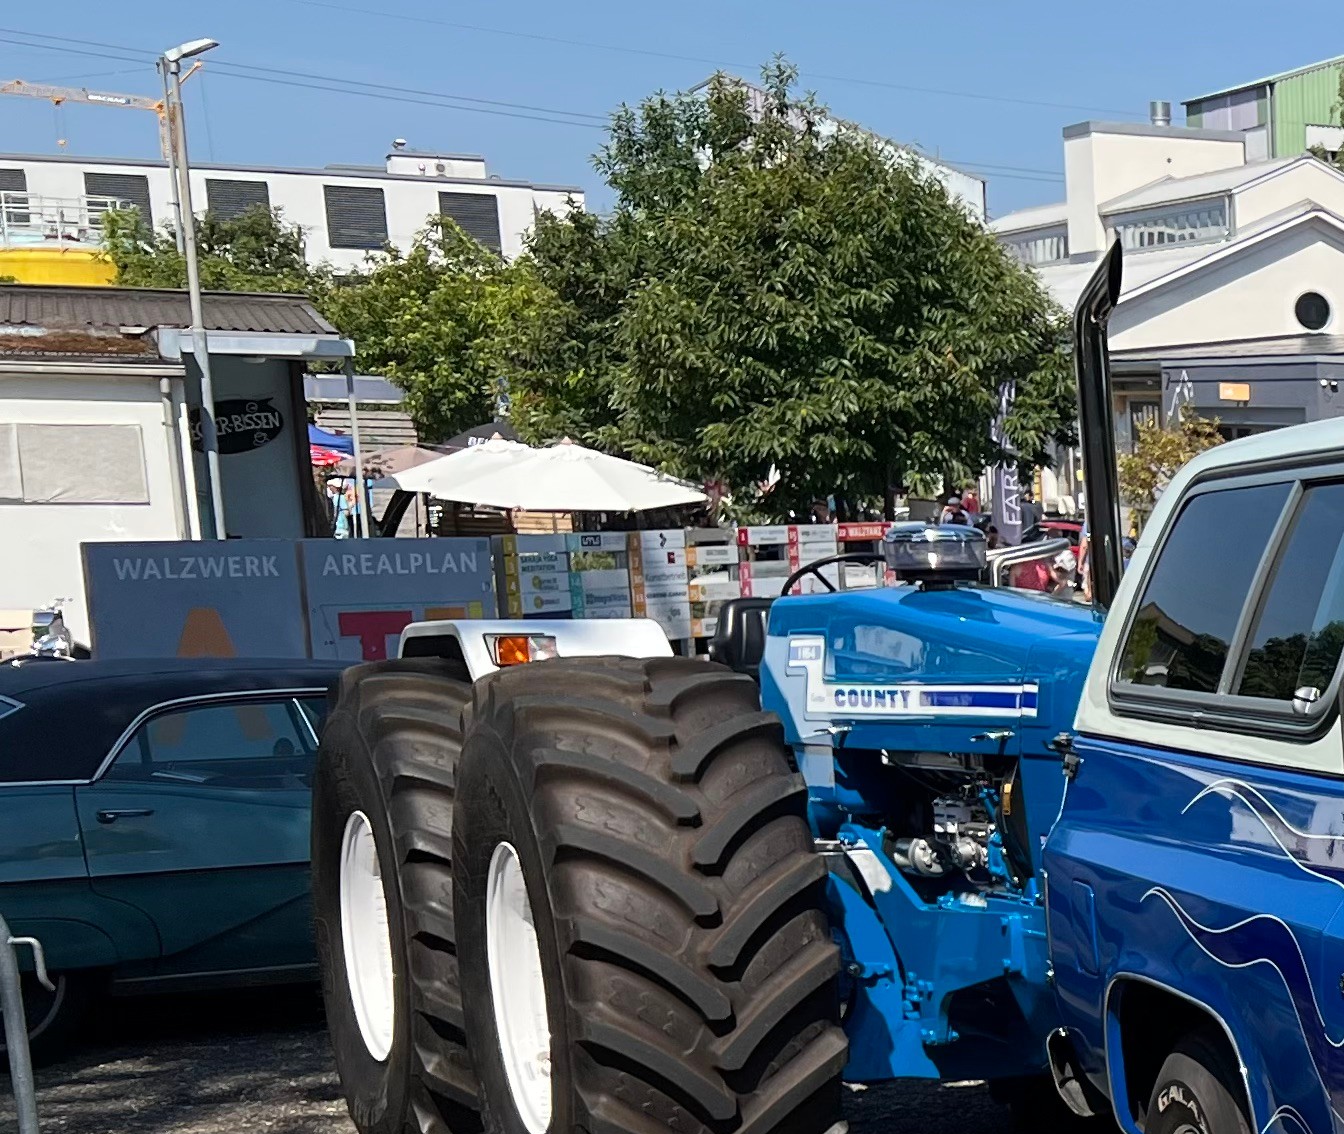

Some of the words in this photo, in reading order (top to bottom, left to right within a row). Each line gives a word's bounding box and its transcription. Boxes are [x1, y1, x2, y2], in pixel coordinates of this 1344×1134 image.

[113, 554, 280, 580] WALZWERK
[321, 551, 479, 577] AREALPLAN
[834, 689, 911, 709] COUNTY
